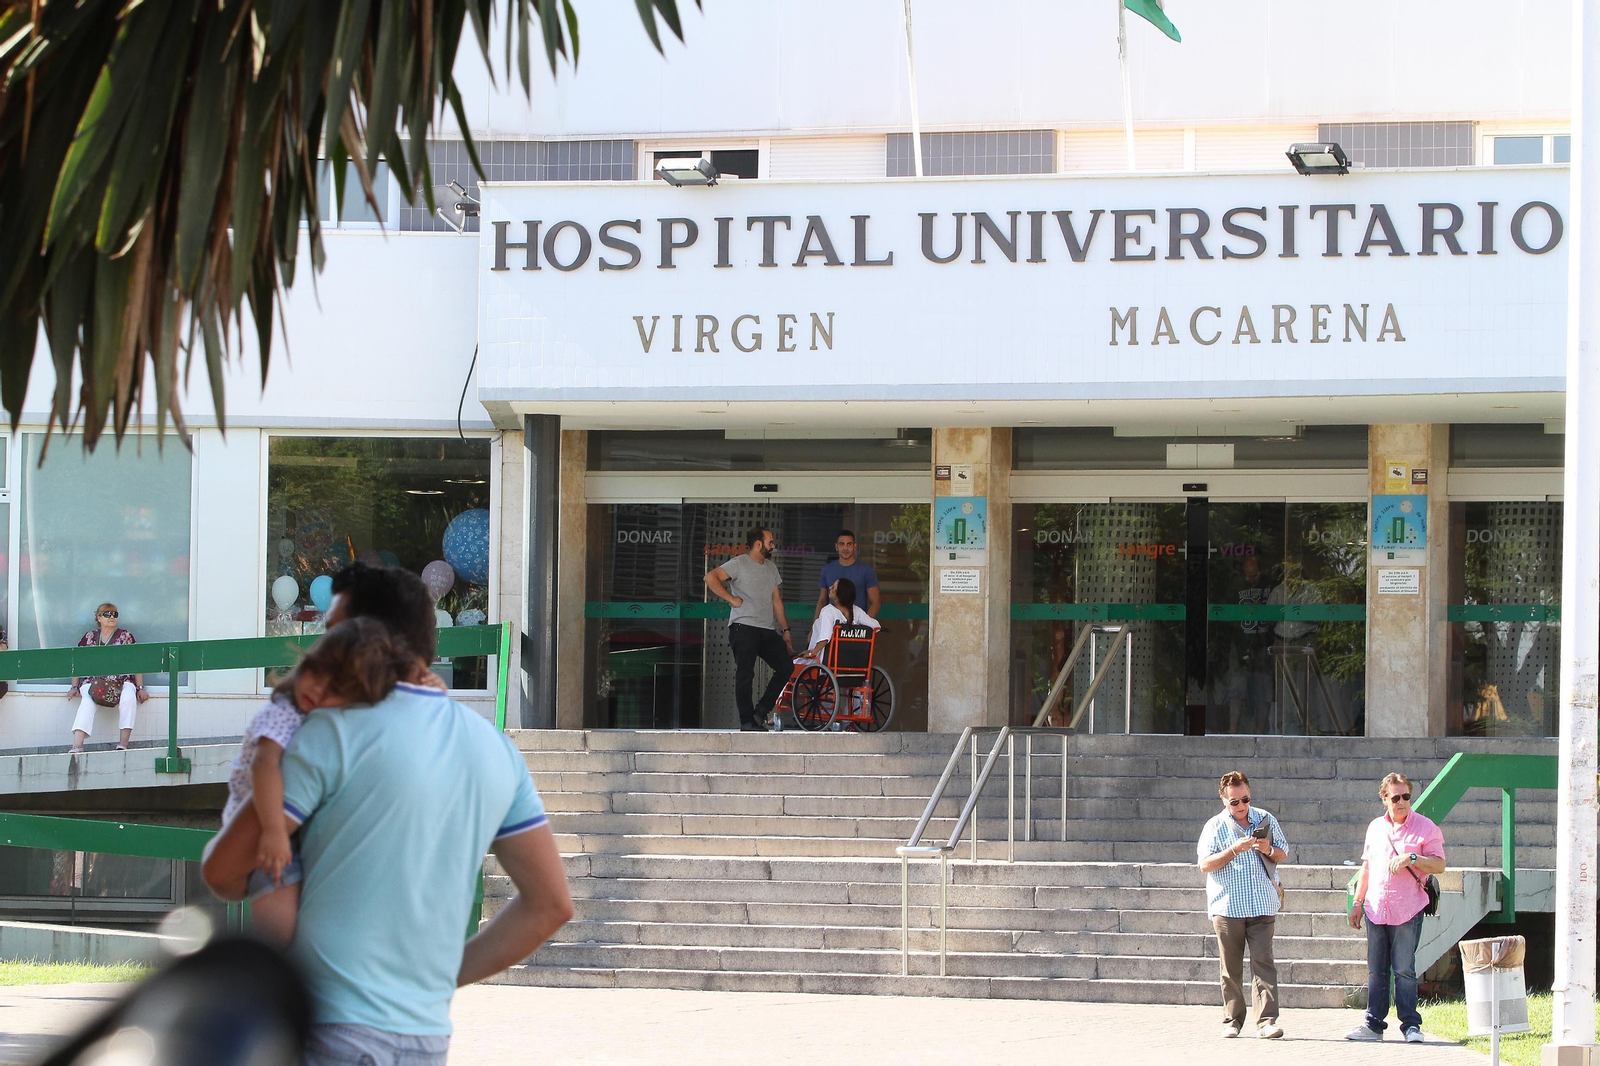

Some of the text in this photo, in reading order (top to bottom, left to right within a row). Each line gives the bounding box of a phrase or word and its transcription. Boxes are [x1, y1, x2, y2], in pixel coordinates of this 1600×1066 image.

[490, 200, 1564, 272] HOSPITAL UNIVERSITARIO
[633, 303, 1407, 354] VIRGEN MACARENA
[617, 530, 672, 543] DONAR
[1037, 530, 1094, 544] DONAR
[1118, 542, 1256, 560] sangre vida
